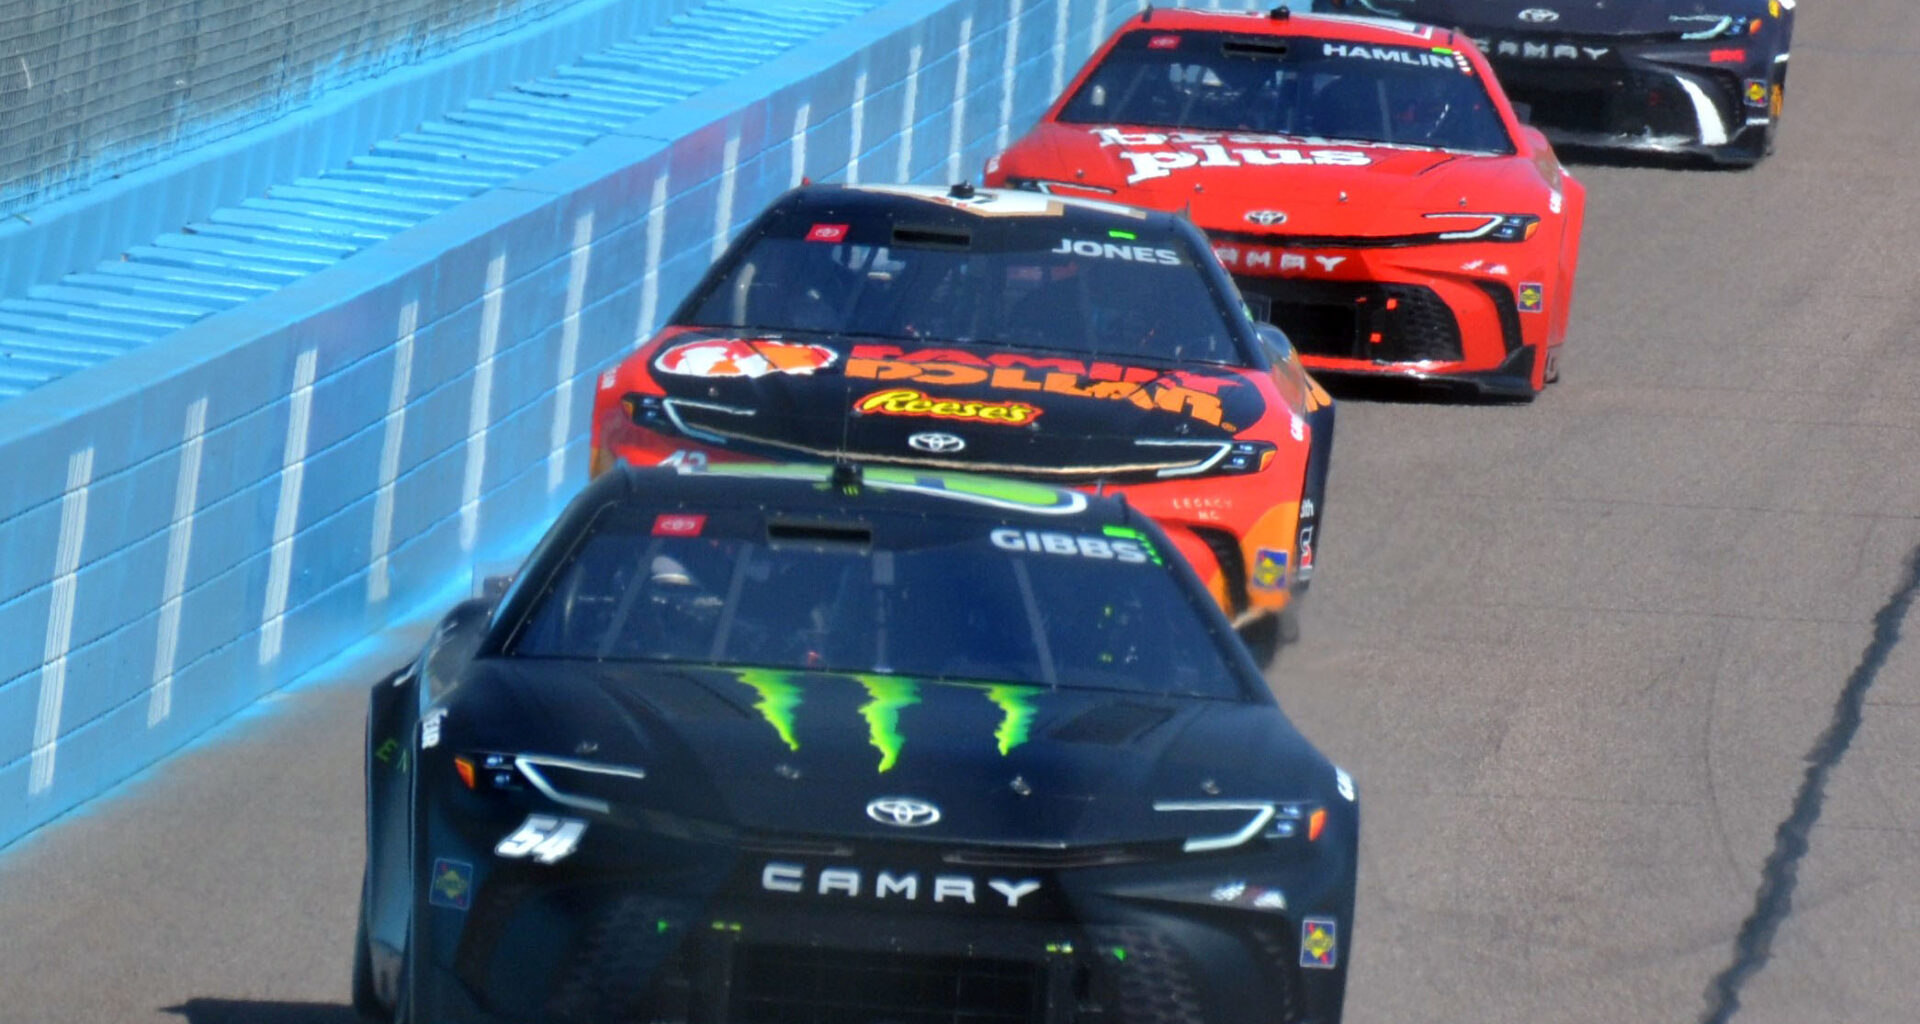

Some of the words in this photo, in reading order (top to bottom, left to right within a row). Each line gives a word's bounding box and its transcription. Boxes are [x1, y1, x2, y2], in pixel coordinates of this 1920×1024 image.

[1322, 43, 1455, 69] HAMLIN
[1119, 142, 1371, 184] plus
[1052, 238, 1182, 266] JONES
[1214, 246, 1348, 273] AMRY
[844, 358, 1223, 428] DOLLAR
[863, 389, 1034, 424] Reese's
[1172, 497, 1233, 509] LEGACY
[989, 527, 1148, 565] GIBBS
[494, 813, 591, 866] 54
[761, 860, 1042, 908] CAMRY
